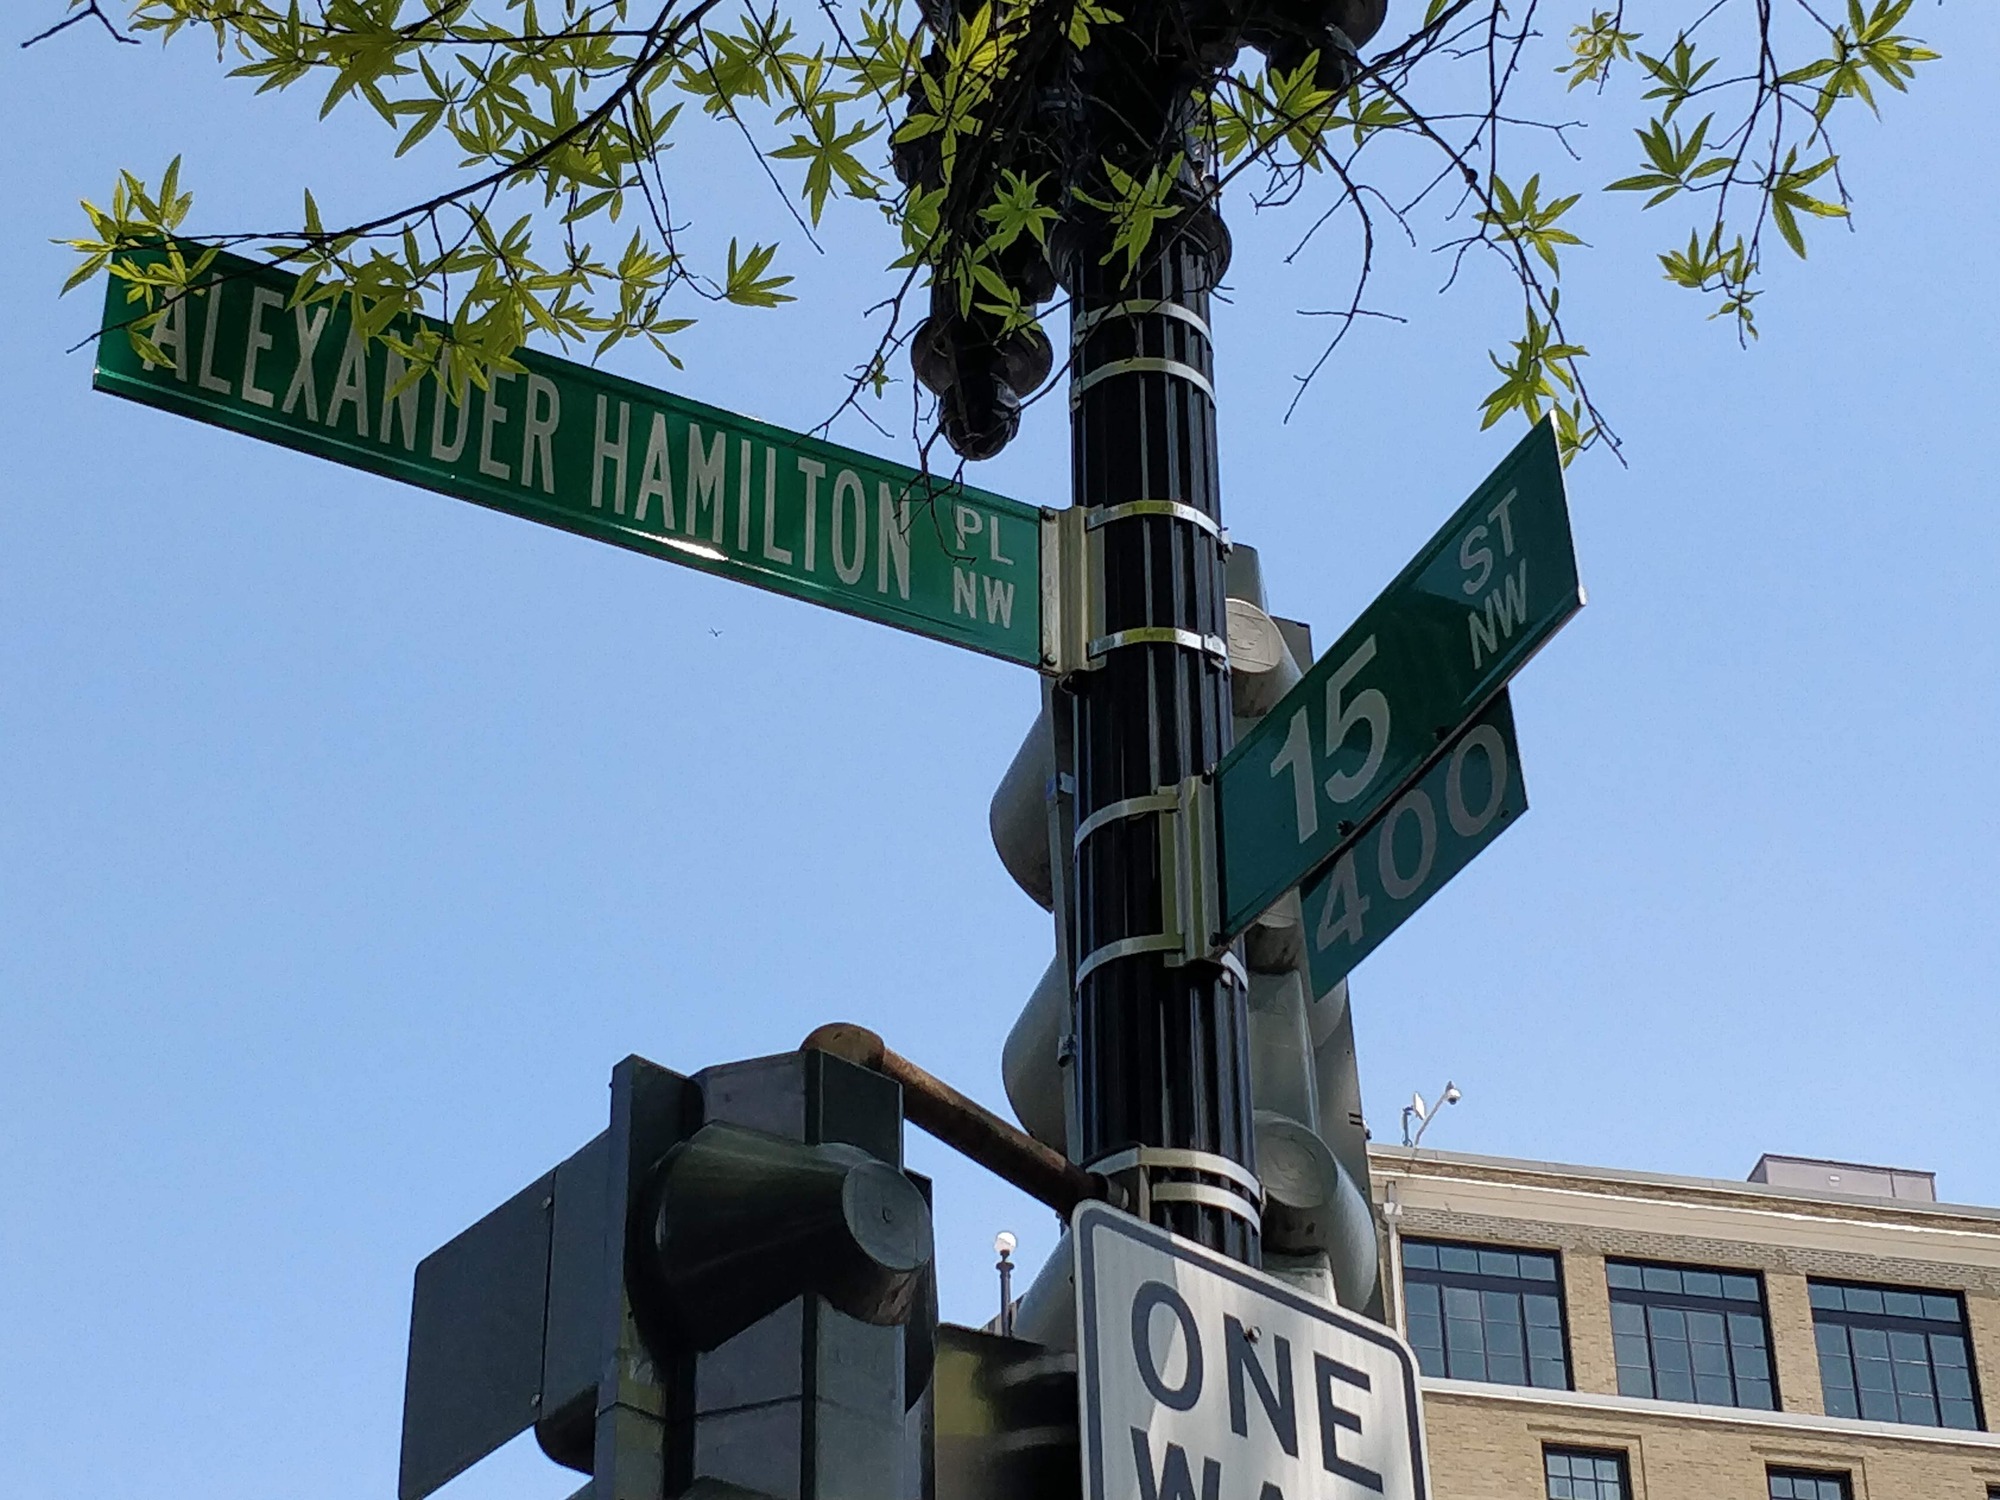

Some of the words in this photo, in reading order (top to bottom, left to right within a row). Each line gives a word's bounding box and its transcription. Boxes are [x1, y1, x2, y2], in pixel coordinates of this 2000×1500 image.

[142, 266, 559, 495] ALEXANDER
[590, 394, 912, 600] HAMILTON
[952, 566, 1015, 630] NW
[955, 504, 1015, 565] PL
[1459, 487, 1517, 596] ST
[1467, 557, 1528, 671] NW
[1270, 634, 1390, 844] 15
[1316, 723, 1505, 953] 400
[1131, 1279, 1384, 1494] ONE
